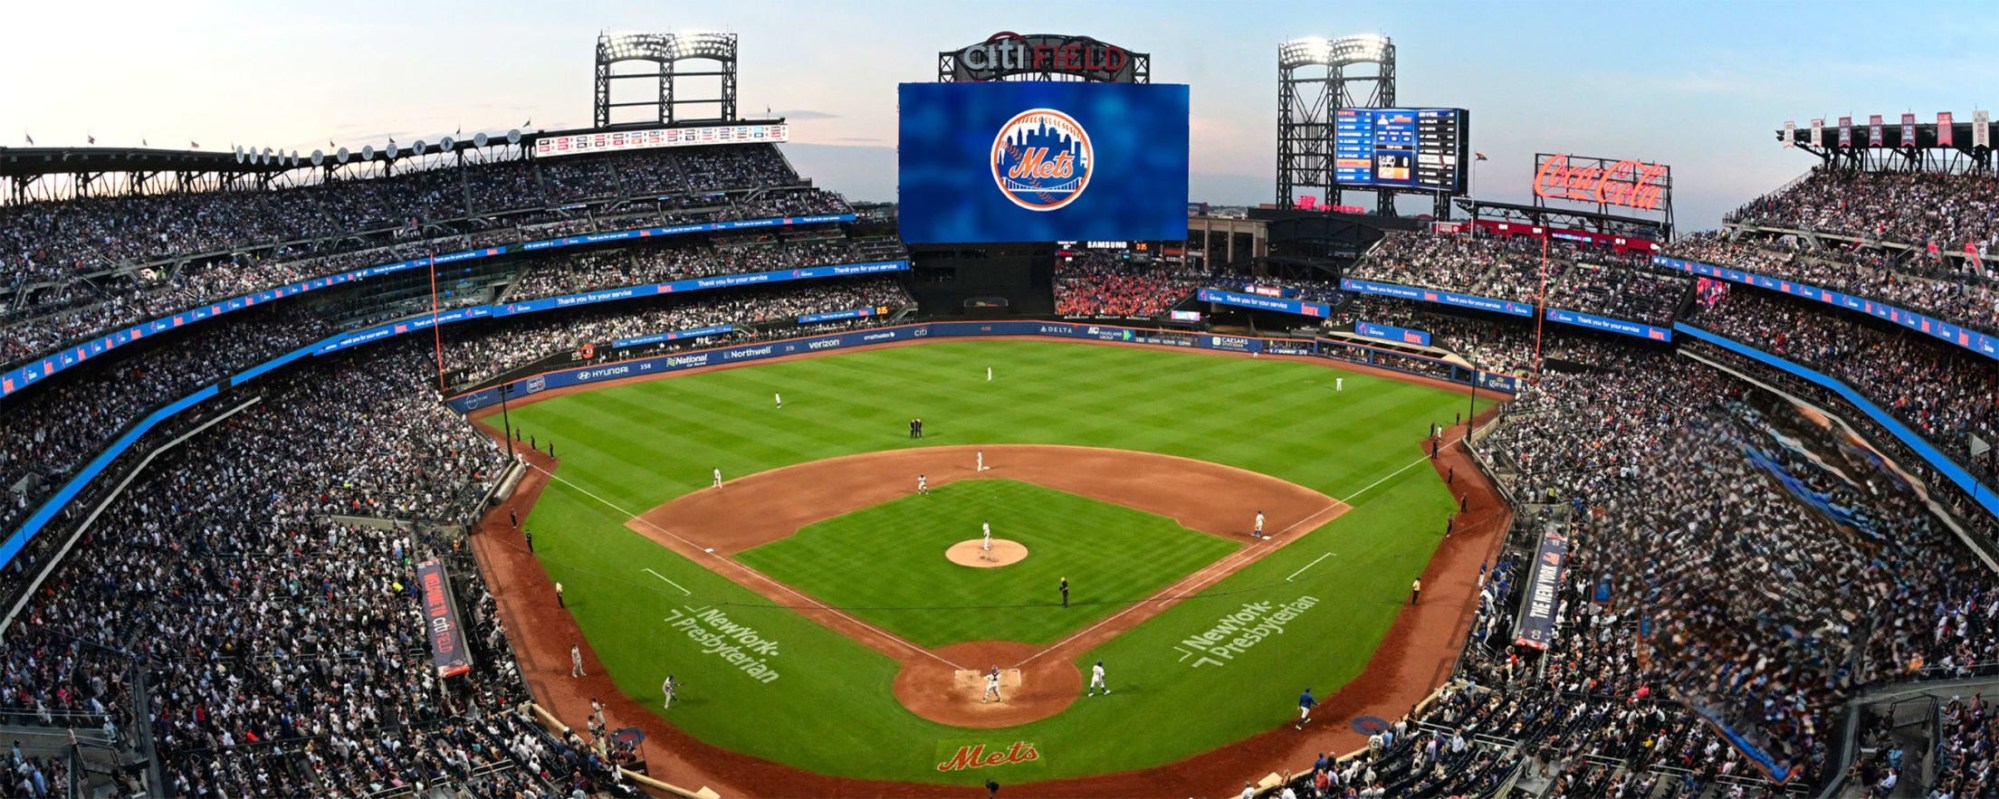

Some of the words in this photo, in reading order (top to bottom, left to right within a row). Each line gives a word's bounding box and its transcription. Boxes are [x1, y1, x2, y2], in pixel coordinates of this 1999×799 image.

[963, 38, 1025, 70] citi
[1034, 44, 1126, 70] FIELD
[1009, 147, 1075, 178] Mets
[1087, 241, 1128, 249] SAMSUNG
[1048, 326, 1073, 334] DELTA
[808, 339, 840, 350] verizon
[1221, 337, 1248, 345] CAESARS
[675, 353, 708, 365] National
[731, 345, 772, 359] Northwell
[592, 366, 629, 378] HYUNDAI
[1538, 564, 1557, 584] YORK
[1534, 583, 1553, 603] NEW
[430, 605, 448, 617] TO
[1529, 601, 1551, 618] THE
[1208, 595, 1320, 660] Presbyterian
[437, 632, 454, 653] FIELD
[671, 617, 779, 684] Presbyterian
[937, 741, 1039, 772] Mets
